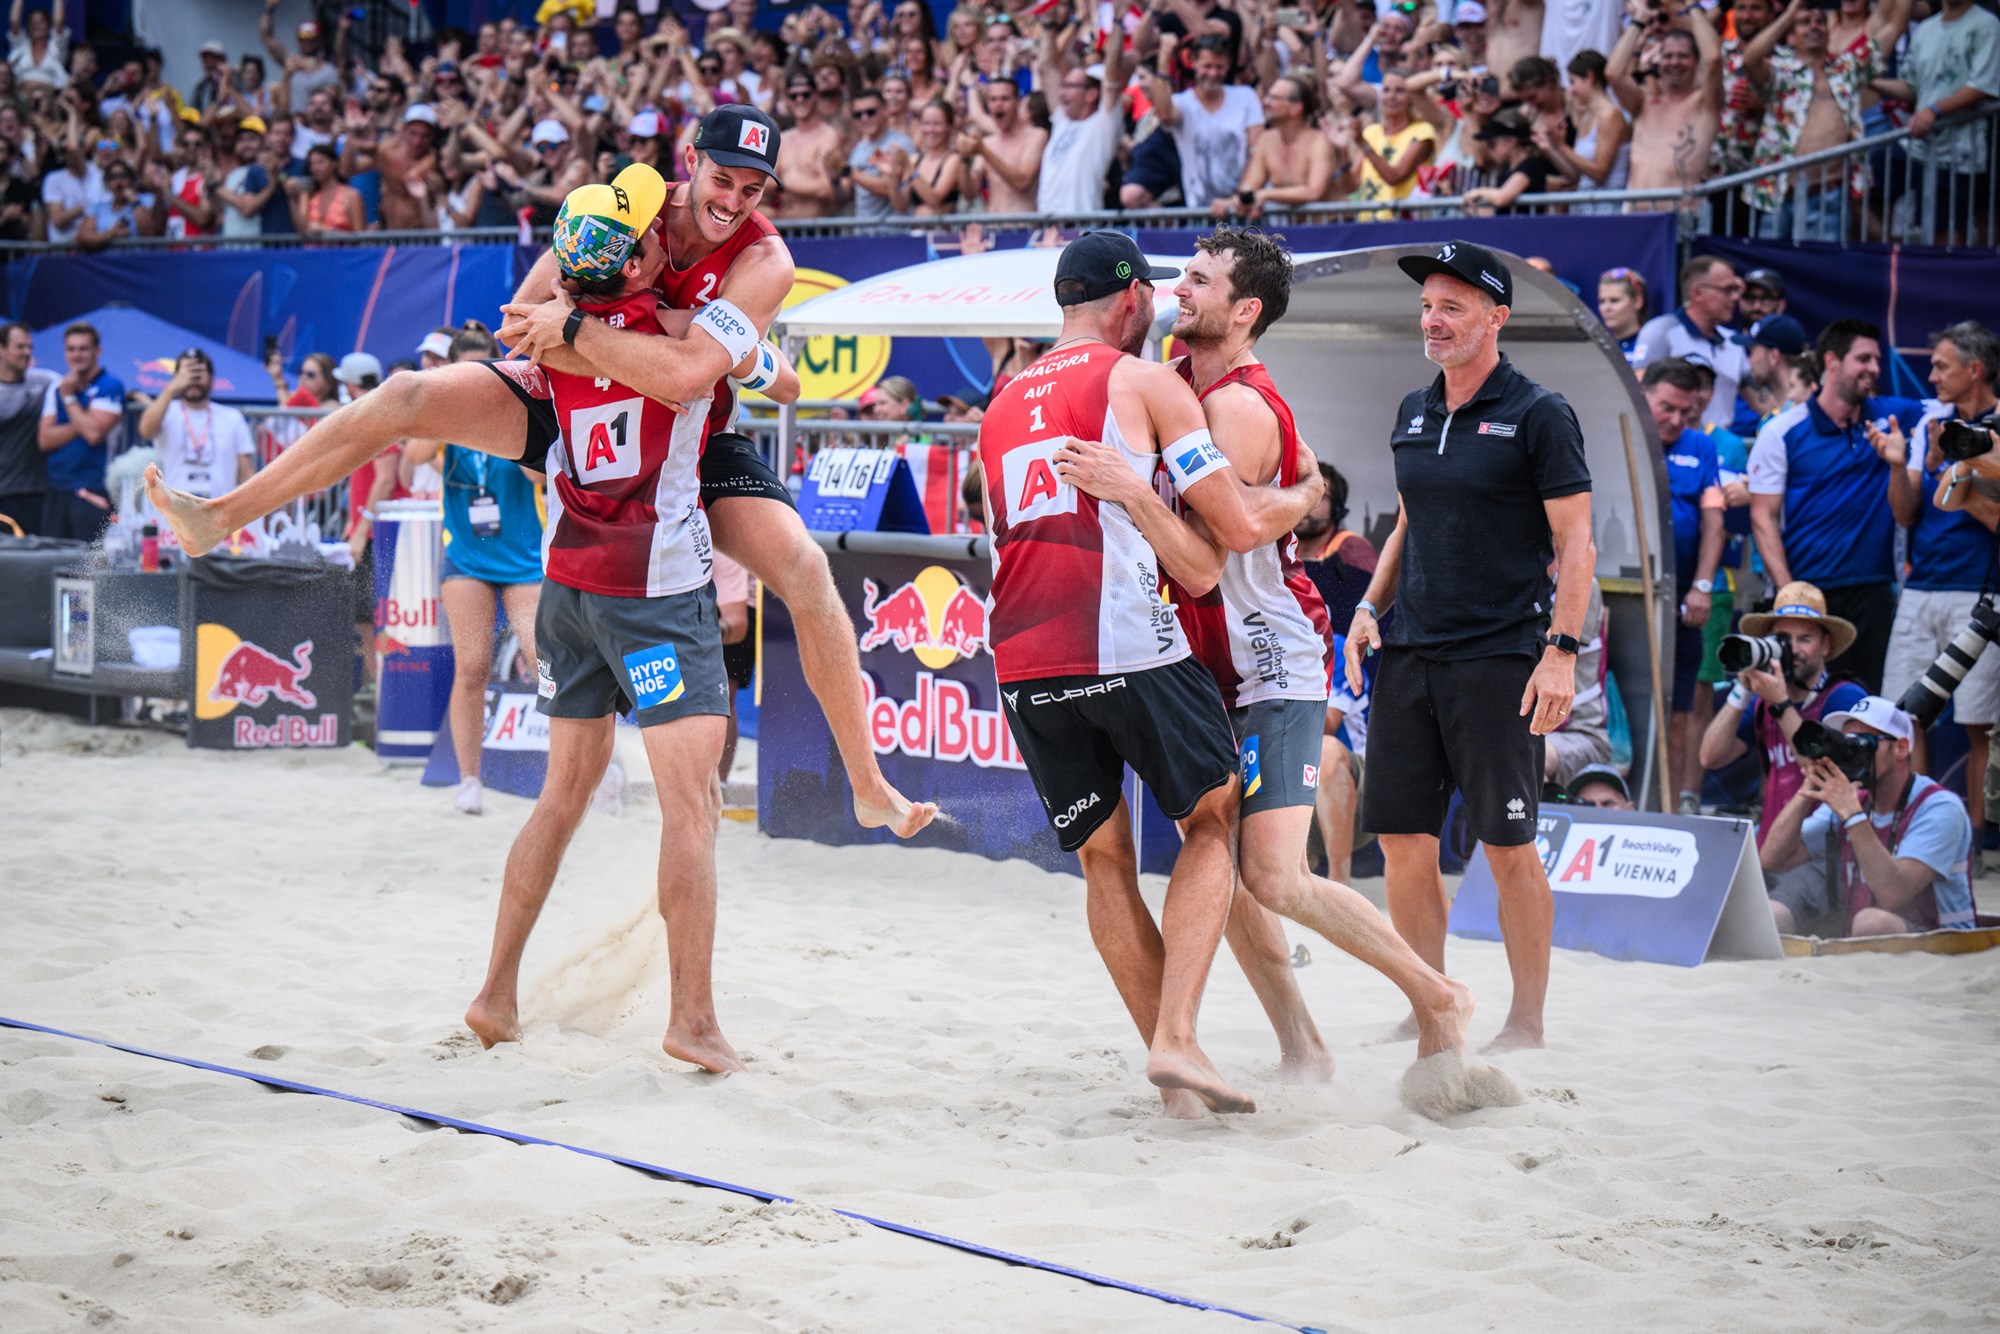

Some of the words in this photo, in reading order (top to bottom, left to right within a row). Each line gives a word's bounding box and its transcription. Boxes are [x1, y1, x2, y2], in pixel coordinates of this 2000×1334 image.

[743, 127, 767, 148] A1
[696, 273, 717, 303] 2
[706, 311, 733, 336] NOE
[712, 305, 746, 336] HYPO
[1024, 381, 1057, 400] AUT
[1029, 405, 1046, 432] 1
[585, 411, 628, 471] A1
[824, 463, 843, 489] 14
[848, 464, 870, 489] 16
[385, 597, 438, 628] Bull
[629, 656, 676, 682] HYPO
[633, 674, 668, 697] NOE
[1030, 676, 1127, 706] CUPRA
[495, 703, 529, 741] A1
[861, 673, 930, 753] ed
[234, 715, 287, 746] Red
[287, 714, 338, 746] Bull
[1559, 834, 1615, 882] A1
[1614, 862, 1676, 884] VIENNA
